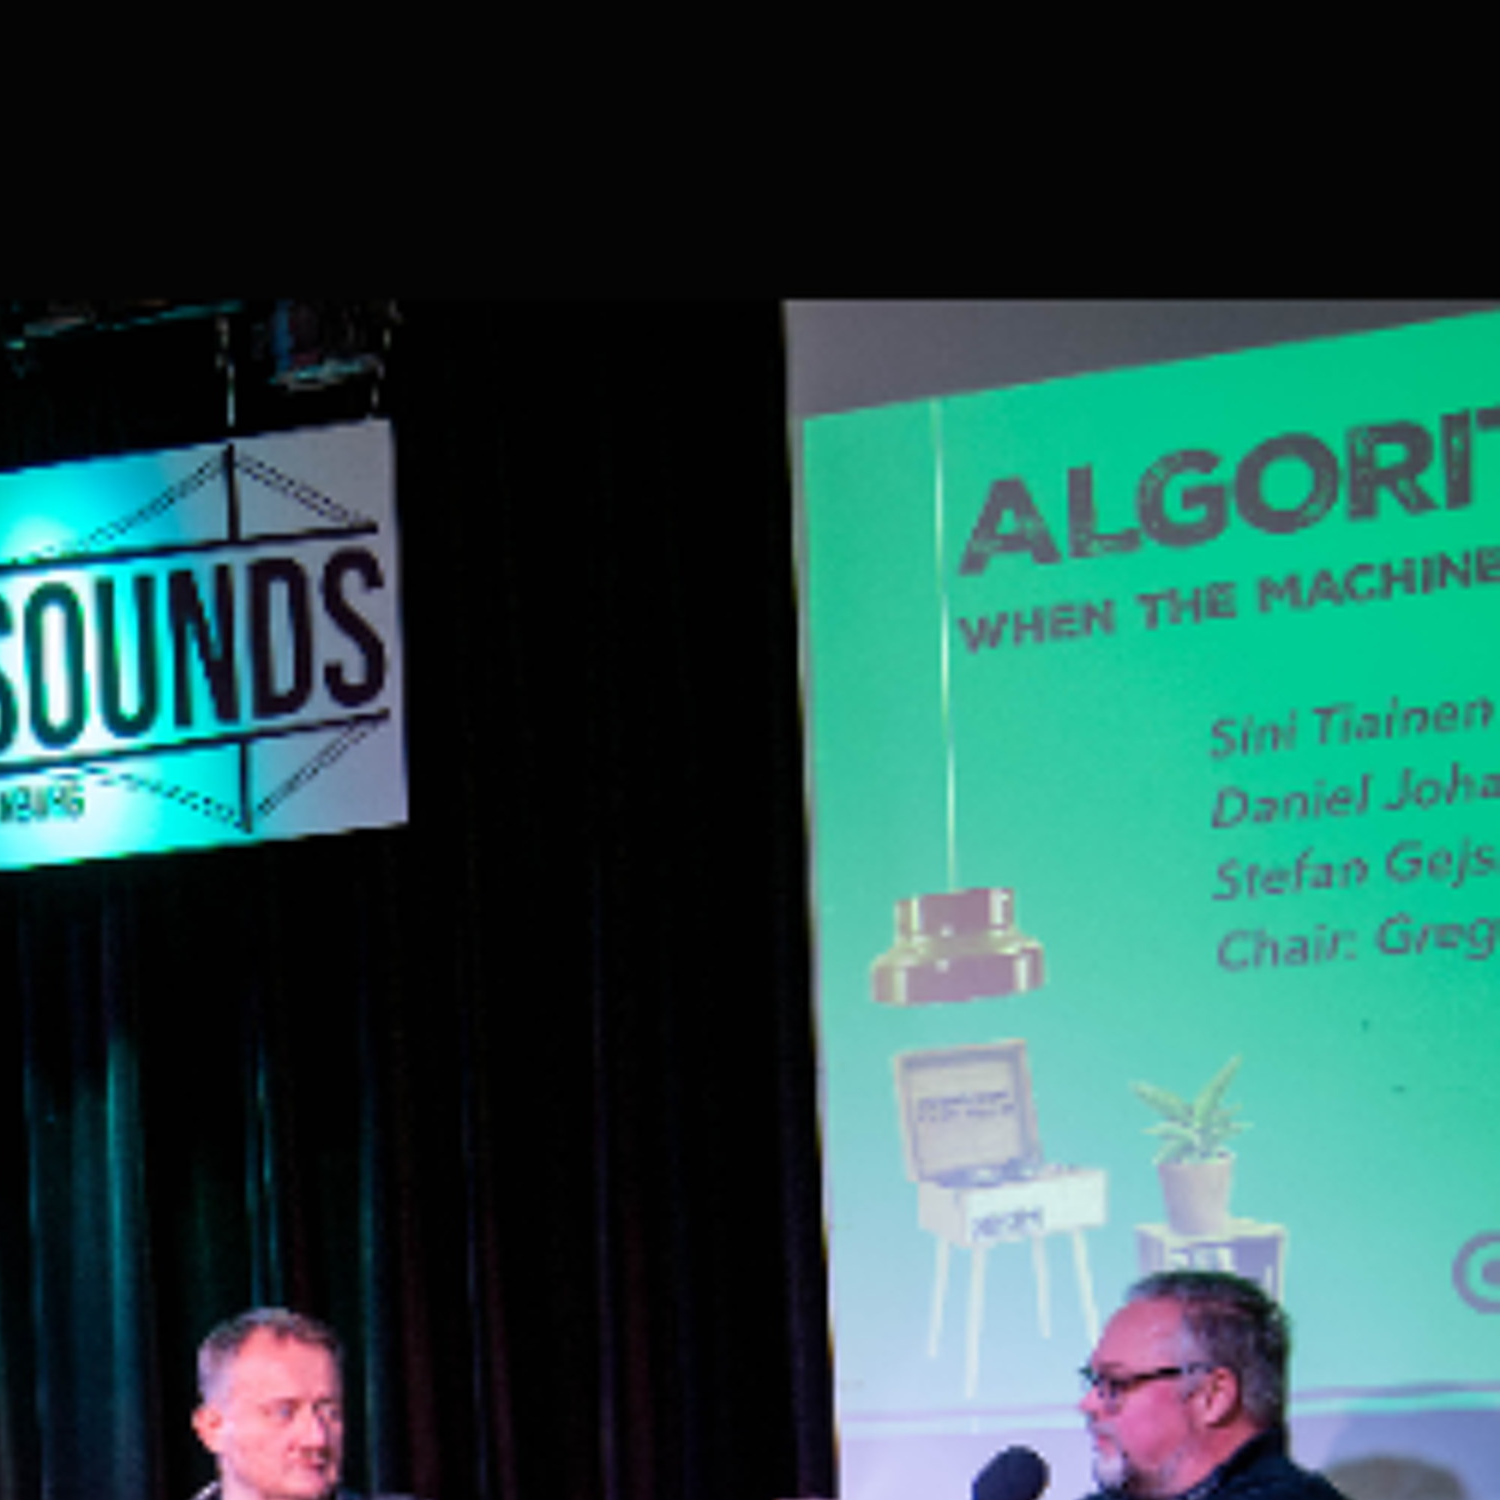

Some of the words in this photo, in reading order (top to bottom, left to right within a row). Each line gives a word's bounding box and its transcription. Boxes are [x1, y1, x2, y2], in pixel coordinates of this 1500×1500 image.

[958, 600, 1117, 654] WHEN
[1136, 582, 1238, 630] THE
[1210, 708, 1297, 761] Sini
[1312, 696, 1495, 745] Tiainen
[1211, 773, 1372, 829] Daniel
[1211, 846, 1369, 901] Stefan
[1217, 924, 1357, 972] Chair:
